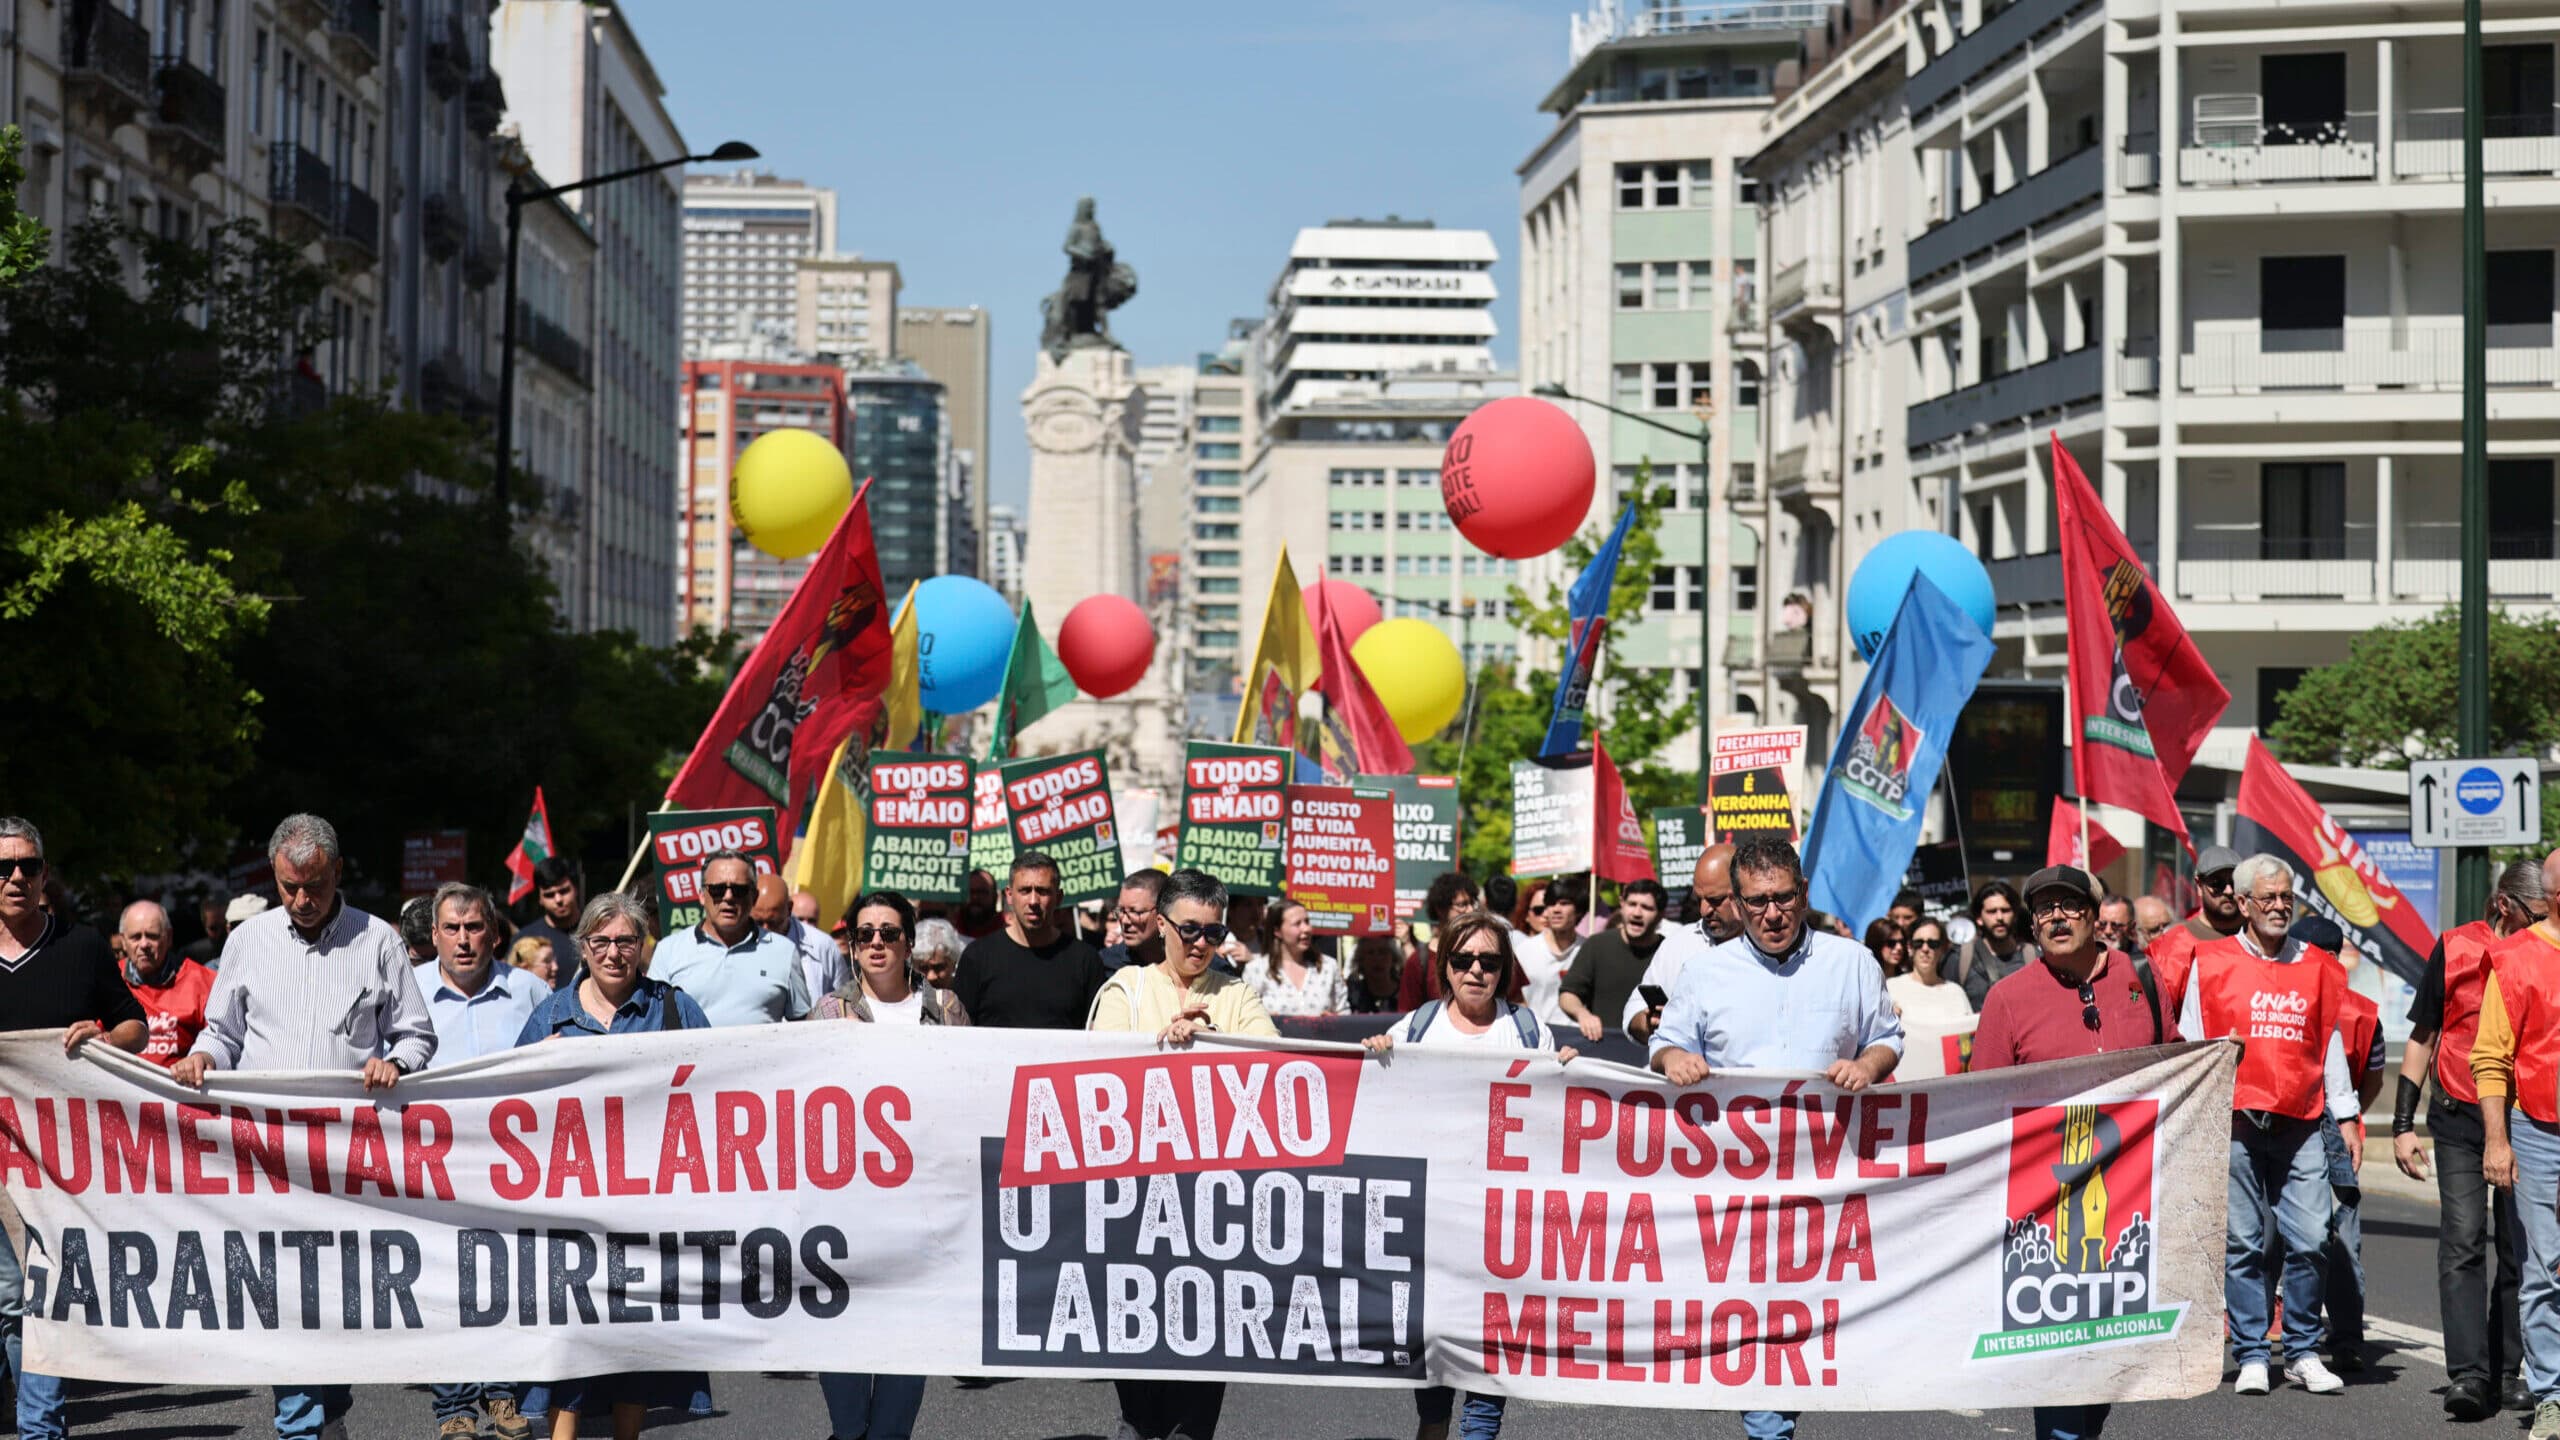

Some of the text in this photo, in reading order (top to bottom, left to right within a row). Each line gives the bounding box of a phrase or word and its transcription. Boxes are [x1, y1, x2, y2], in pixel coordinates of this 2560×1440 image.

[1733, 749, 1789, 769] PORTUGAL
[876, 764, 964, 790] TODOS
[1191, 759, 1280, 784] TODOS
[1514, 769, 1544, 785] PAZ
[1743, 773, 1755, 792] É
[1846, 757, 1903, 801] CGTP
[908, 788, 927, 801] AO
[1010, 761, 1098, 806] TODOS
[1222, 783, 1240, 798] AO
[898, 801, 965, 823] MAIO
[1046, 796, 1064, 811] AO
[1212, 794, 1280, 819] MAIO
[1291, 800, 1361, 818] O CUSTO
[1712, 794, 1790, 811] VERGONHA
[1040, 795, 1108, 835] MAIO
[1291, 817, 1355, 835] DE VIDA
[1657, 819, 1684, 832] PAZ
[1717, 813, 1790, 830] NACIONAL
[659, 821, 763, 860] TODOS
[872, 835, 946, 856] ABAIXO
[1185, 827, 1259, 849] ABAIXO
[1292, 834, 1376, 855] AUMENTA,
[1658, 831, 1686, 846] PÃO
[870, 853, 963, 875] O PACOTE
[1183, 845, 1198, 862] O
[1200, 846, 1275, 869] PACOTE
[1291, 853, 1390, 873] O POVO NÃO
[869, 871, 960, 892] LABORAL
[1292, 870, 1376, 889] AGUENTA!
[2292, 873, 2384, 962] LEIRIA
[2250, 990, 2307, 1013] UNIÃO
[2251, 1010, 2306, 1026] DOS SINDICATOS
[2250, 1024, 2304, 1043] LISBOA
[1023, 1060, 1331, 1173] ABAIXO
[1486, 1059, 1948, 1180] É POSSÍVEL
[0, 1064, 914, 1200] AUMENTAR SALÁRIOS
[1000, 1169, 1411, 1272] O PACOTE
[1483, 1187, 1877, 1283] UMA VIDA
[457, 1224, 850, 1328] DIREITOS
[2006, 1271, 2146, 1324] CGTP
[997, 1259, 1411, 1367] LABORAL!
[1482, 1292, 1840, 1387] MELHOR!
[1983, 1317, 2165, 1353] INTERSINDICAL NACIONAL
